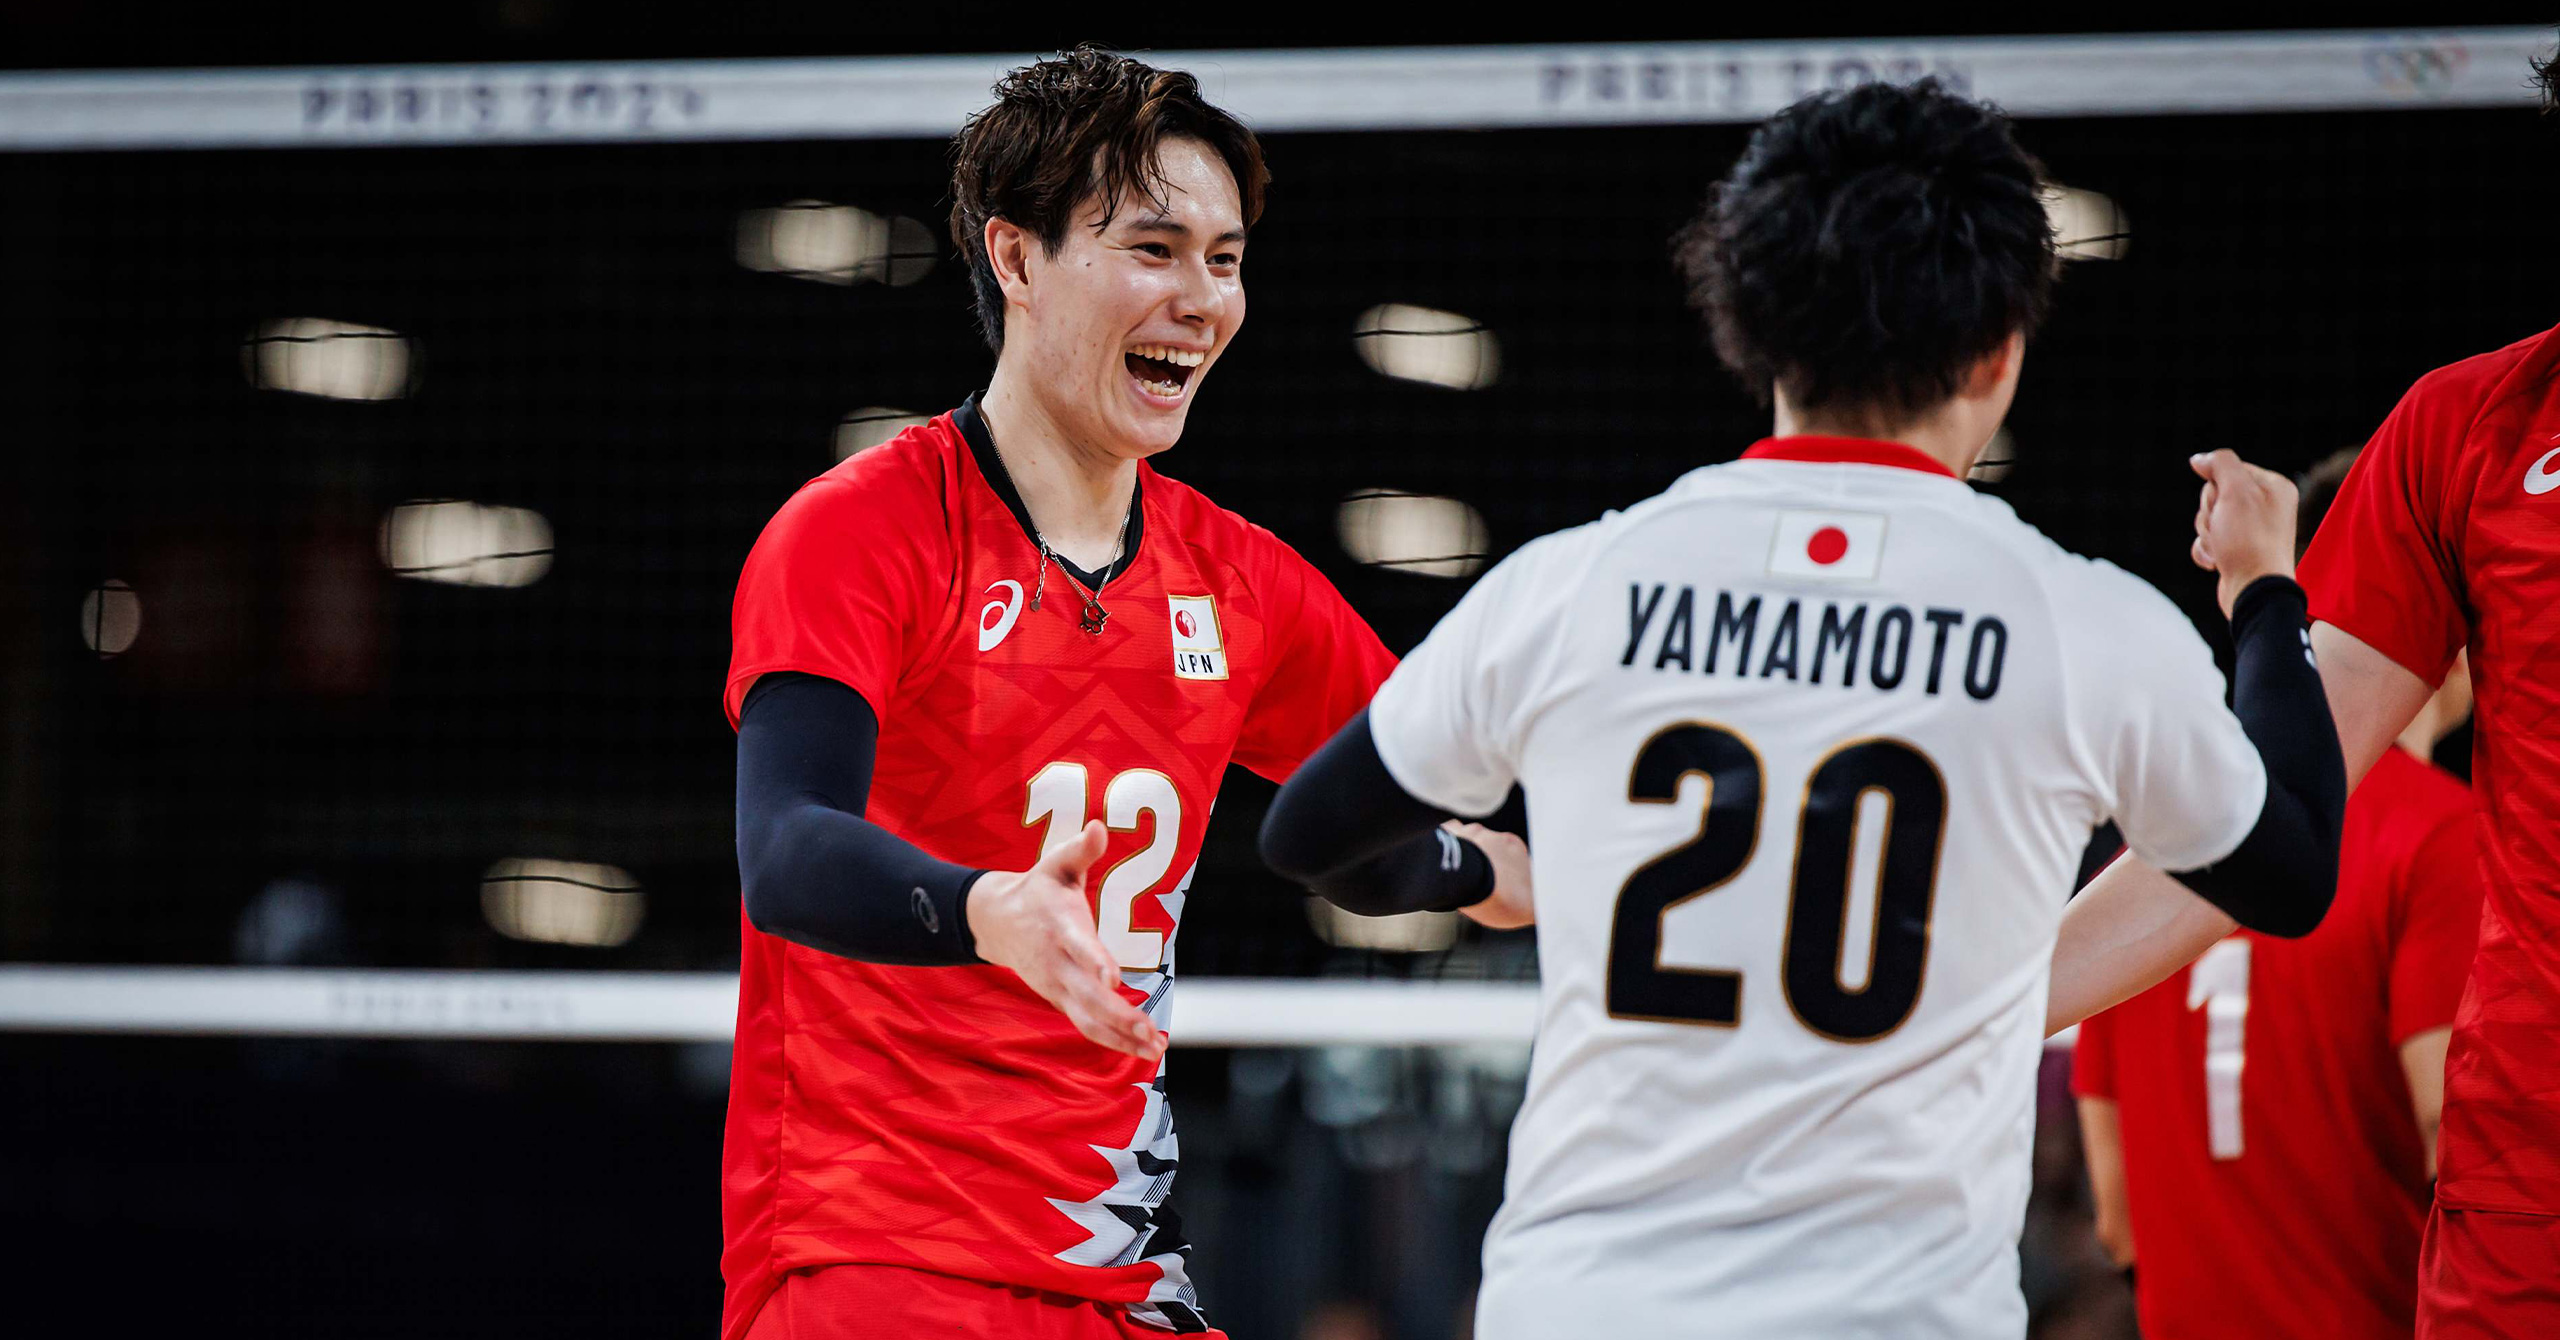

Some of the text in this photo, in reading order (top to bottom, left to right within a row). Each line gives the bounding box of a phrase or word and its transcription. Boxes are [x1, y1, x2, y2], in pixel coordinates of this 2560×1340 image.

[304, 84, 500, 132] PARIS
[1178, 653, 1214, 674] JPN
[1621, 583, 2008, 701] YAMAMOTO
[1021, 760, 1182, 973] 12
[1604, 718, 1949, 1045] 20
[2186, 936, 2251, 1161] 1
